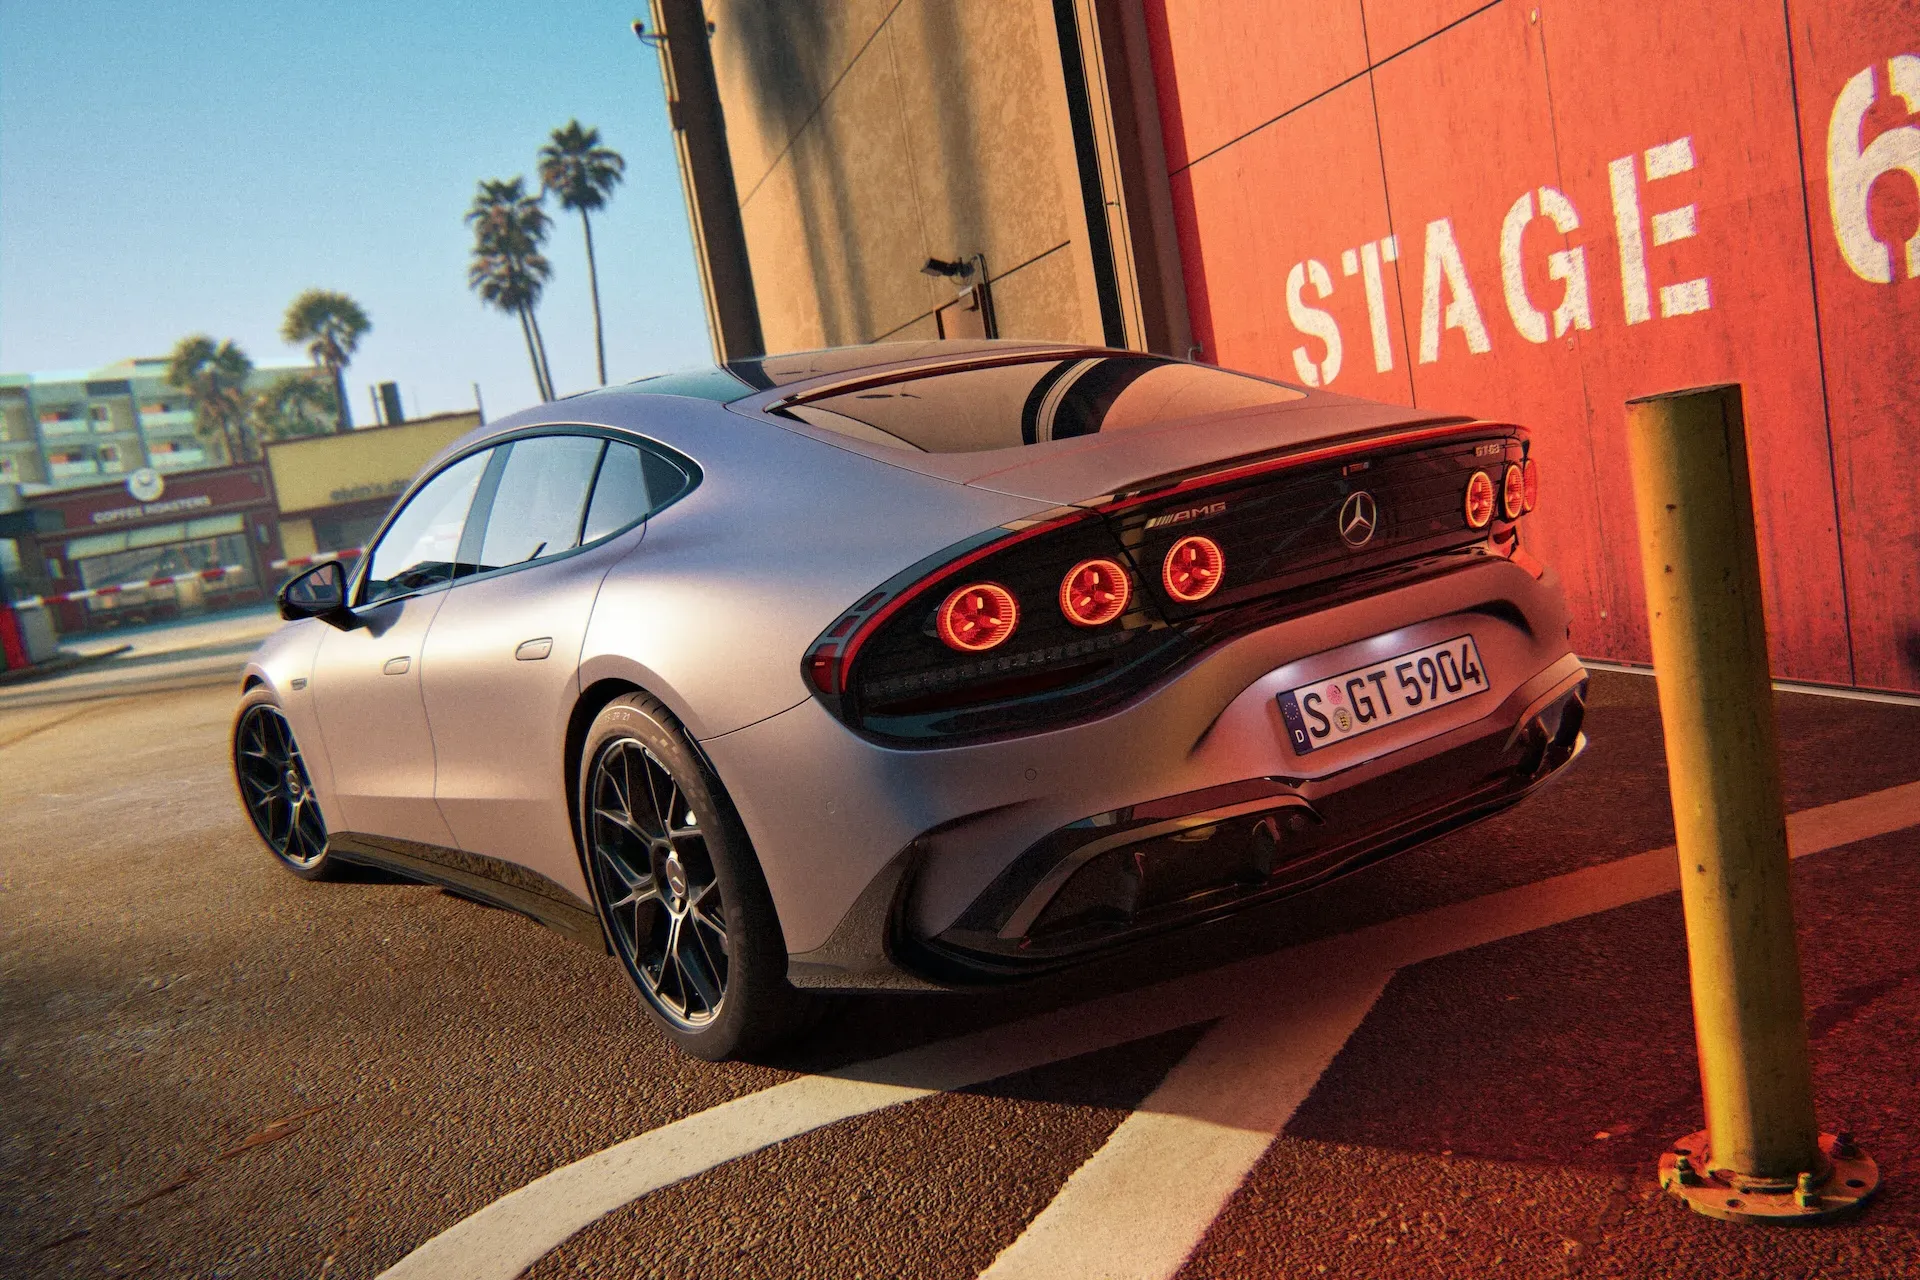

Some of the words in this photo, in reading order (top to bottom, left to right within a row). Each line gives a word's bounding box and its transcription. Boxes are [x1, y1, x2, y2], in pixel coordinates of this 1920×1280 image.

[1285, 135, 1712, 388] STAGE
[1826, 53, 1920, 284] 6
[1173, 502, 1226, 522] AMG
[1303, 692, 1331, 738] S
[1346, 670, 1392, 723] GT
[1395, 643, 1481, 706] 5904
[1295, 729, 1305, 743] D
